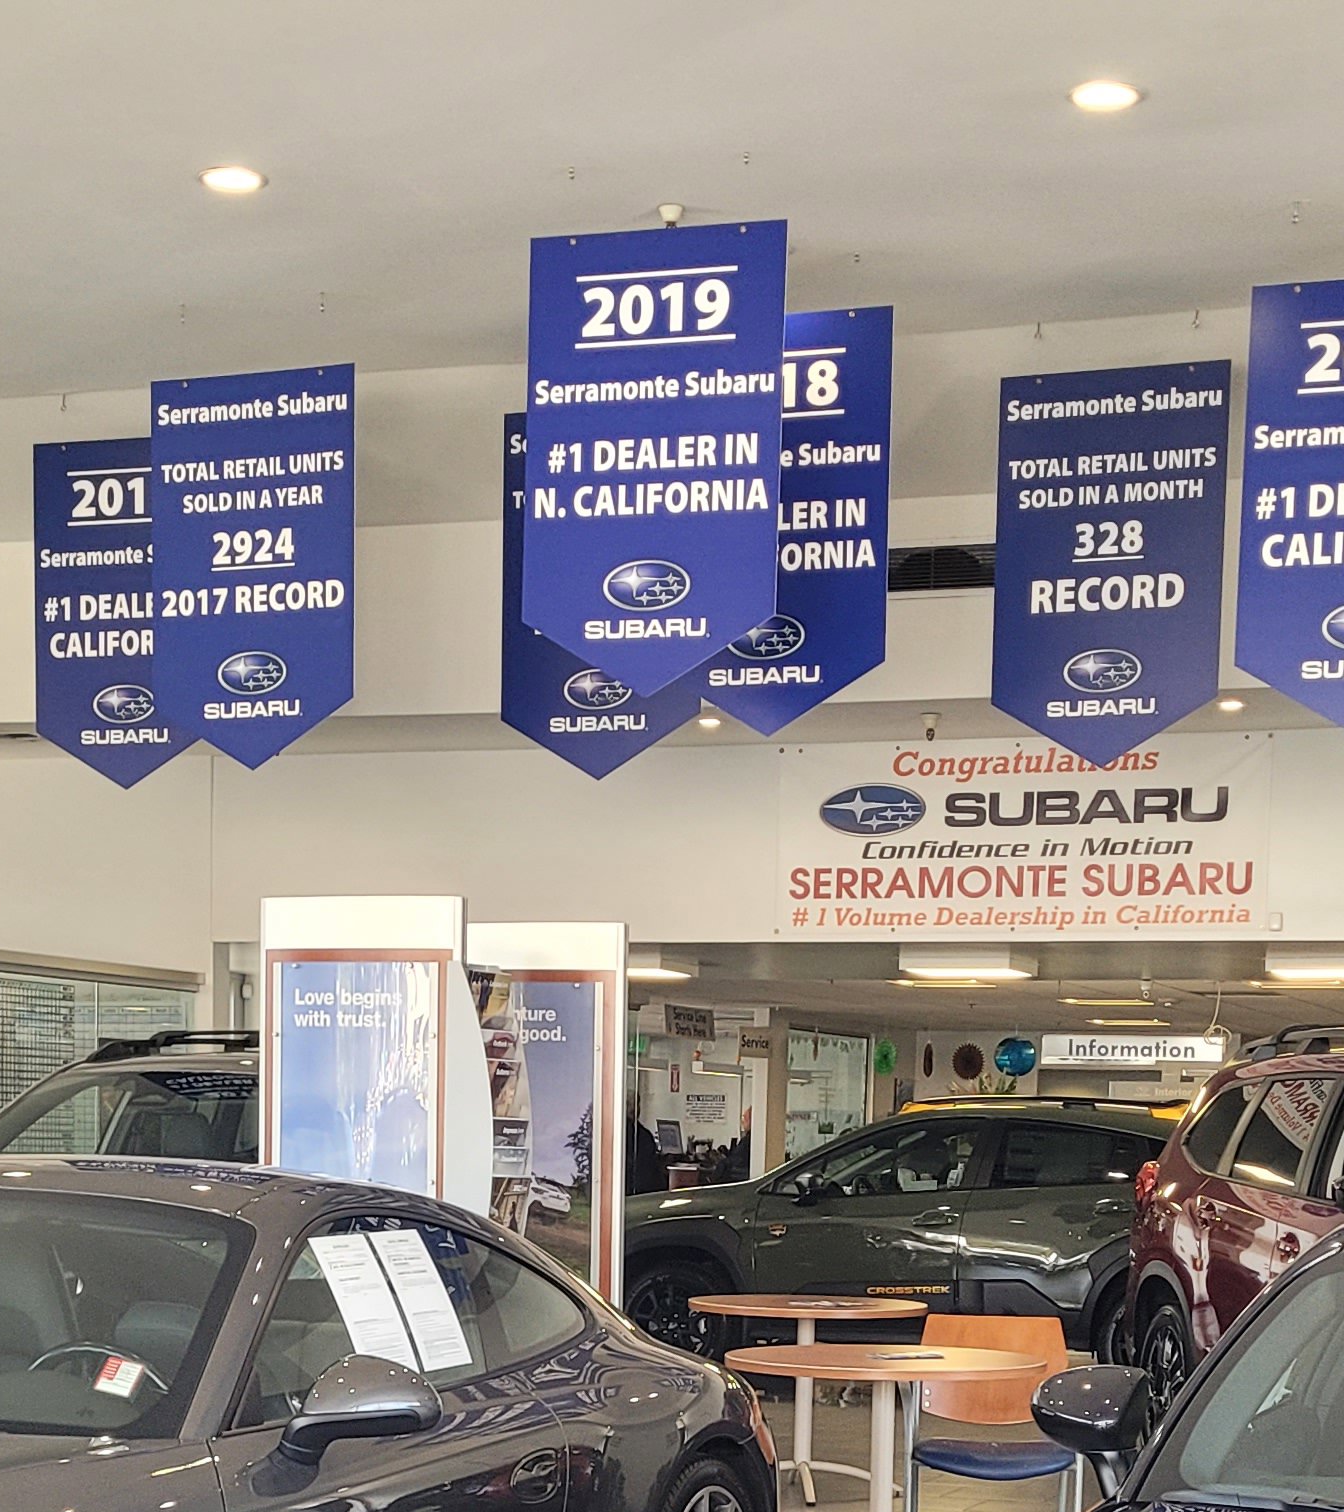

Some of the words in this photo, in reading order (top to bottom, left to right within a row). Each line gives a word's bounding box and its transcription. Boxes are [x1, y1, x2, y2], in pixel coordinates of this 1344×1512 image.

[581, 278, 731, 338] 2019
[535, 374, 679, 405] Serramonte
[685, 369, 776, 396] Subaru
[782, 359, 839, 408] 18
[158, 396, 273, 426] Serramonte
[277, 392, 347, 416] Subaru
[1007, 392, 1136, 422] Serramonte
[1142, 387, 1223, 412] Subaru
[161, 461, 219, 483] TOTAL
[223, 457, 285, 480] RETAIL
[289, 450, 344, 475] UNITS
[548, 445, 584, 474] #1
[593, 437, 717, 472] DEALER
[723, 433, 758, 465] IN
[798, 441, 881, 467] Subaru
[1008, 457, 1073, 480] TOTAL
[1077, 452, 1149, 477] RETAIL
[1153, 446, 1217, 471] UNITS
[71, 477, 146, 518] 201
[182, 493, 232, 514] SOLD
[236, 492, 255, 511] IN
[259, 490, 273, 509] A
[275, 485, 323, 507] YEAR
[534, 487, 567, 519] N.
[573, 478, 769, 518] CALIFORNIA
[1018, 487, 1074, 510] SOLD
[1078, 485, 1099, 506] IN
[1103, 483, 1119, 504] A
[1123, 478, 1204, 502] MONTH
[1256, 487, 1296, 520] #1
[777, 500, 828, 531] LER
[835, 498, 866, 528] IN
[212, 528, 295, 565] 2924
[1073, 519, 1144, 557] 328
[40, 546, 143, 568] Serramonte
[780, 538, 876, 572] ORNIA
[44, 596, 71, 622] #1
[79, 592, 153, 621] DEAL
[161, 588, 227, 617] 2017
[234, 579, 345, 614] RECORD
[1029, 573, 1185, 615] RECORD
[50, 629, 154, 658] CALIFOR
[584, 617, 709, 640] SUBARU
[708, 665, 821, 687] SUBARU
[203, 699, 302, 719] SUBARU
[1046, 697, 1158, 718] SUBARU
[81, 728, 170, 745] SUBARU
[549, 714, 648, 733] SUBARU
[944, 786, 1229, 828] SUBARU
[861, 838, 1029, 860] Confidence
[1040, 838, 1069, 858] in
[1079, 836, 1193, 857] Motion
[788, 864, 1068, 901] SERRAMONTE
[1081, 861, 1254, 898] SUBARU
[834, 906, 927, 927] Volume
[933, 904, 1076, 930] Dealership
[1081, 905, 1107, 925] in
[1115, 902, 1251, 925] California
[294, 988, 334, 1006] Love
[341, 988, 403, 1009] begins
[514, 1006, 557, 1021] nture
[294, 1010, 330, 1027] with
[336, 1010, 386, 1027] trust.
[741, 1035, 769, 1049] Service
[1068, 1039, 1195, 1058] Information
[1155, 1087, 1193, 1097] Interior
[866, 1285, 951, 1294] CROSSTREK
